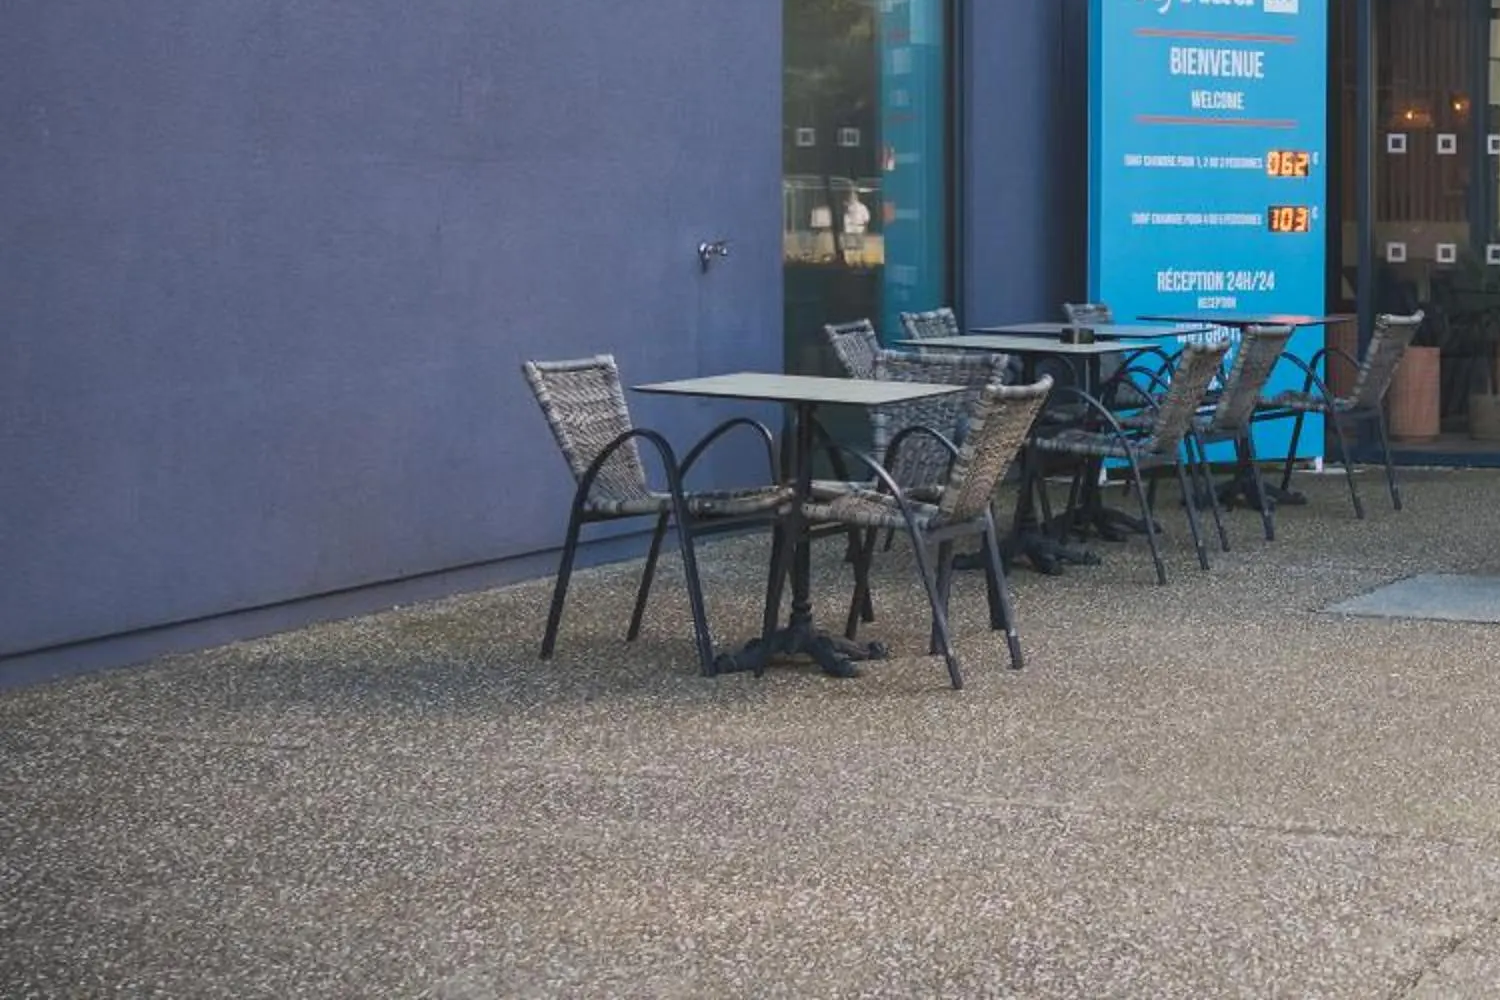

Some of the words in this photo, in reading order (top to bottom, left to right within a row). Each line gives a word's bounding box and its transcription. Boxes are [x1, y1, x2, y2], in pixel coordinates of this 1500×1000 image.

[1170, 47, 1265, 79] BIENVENUE
[1191, 89, 1244, 110] WELCOME
[1267, 151, 1308, 176] 062
[1271, 206, 1308, 231] 103
[1157, 267, 1224, 292] RÉCEPTION
[1226, 270, 1276, 292] 24H/24
